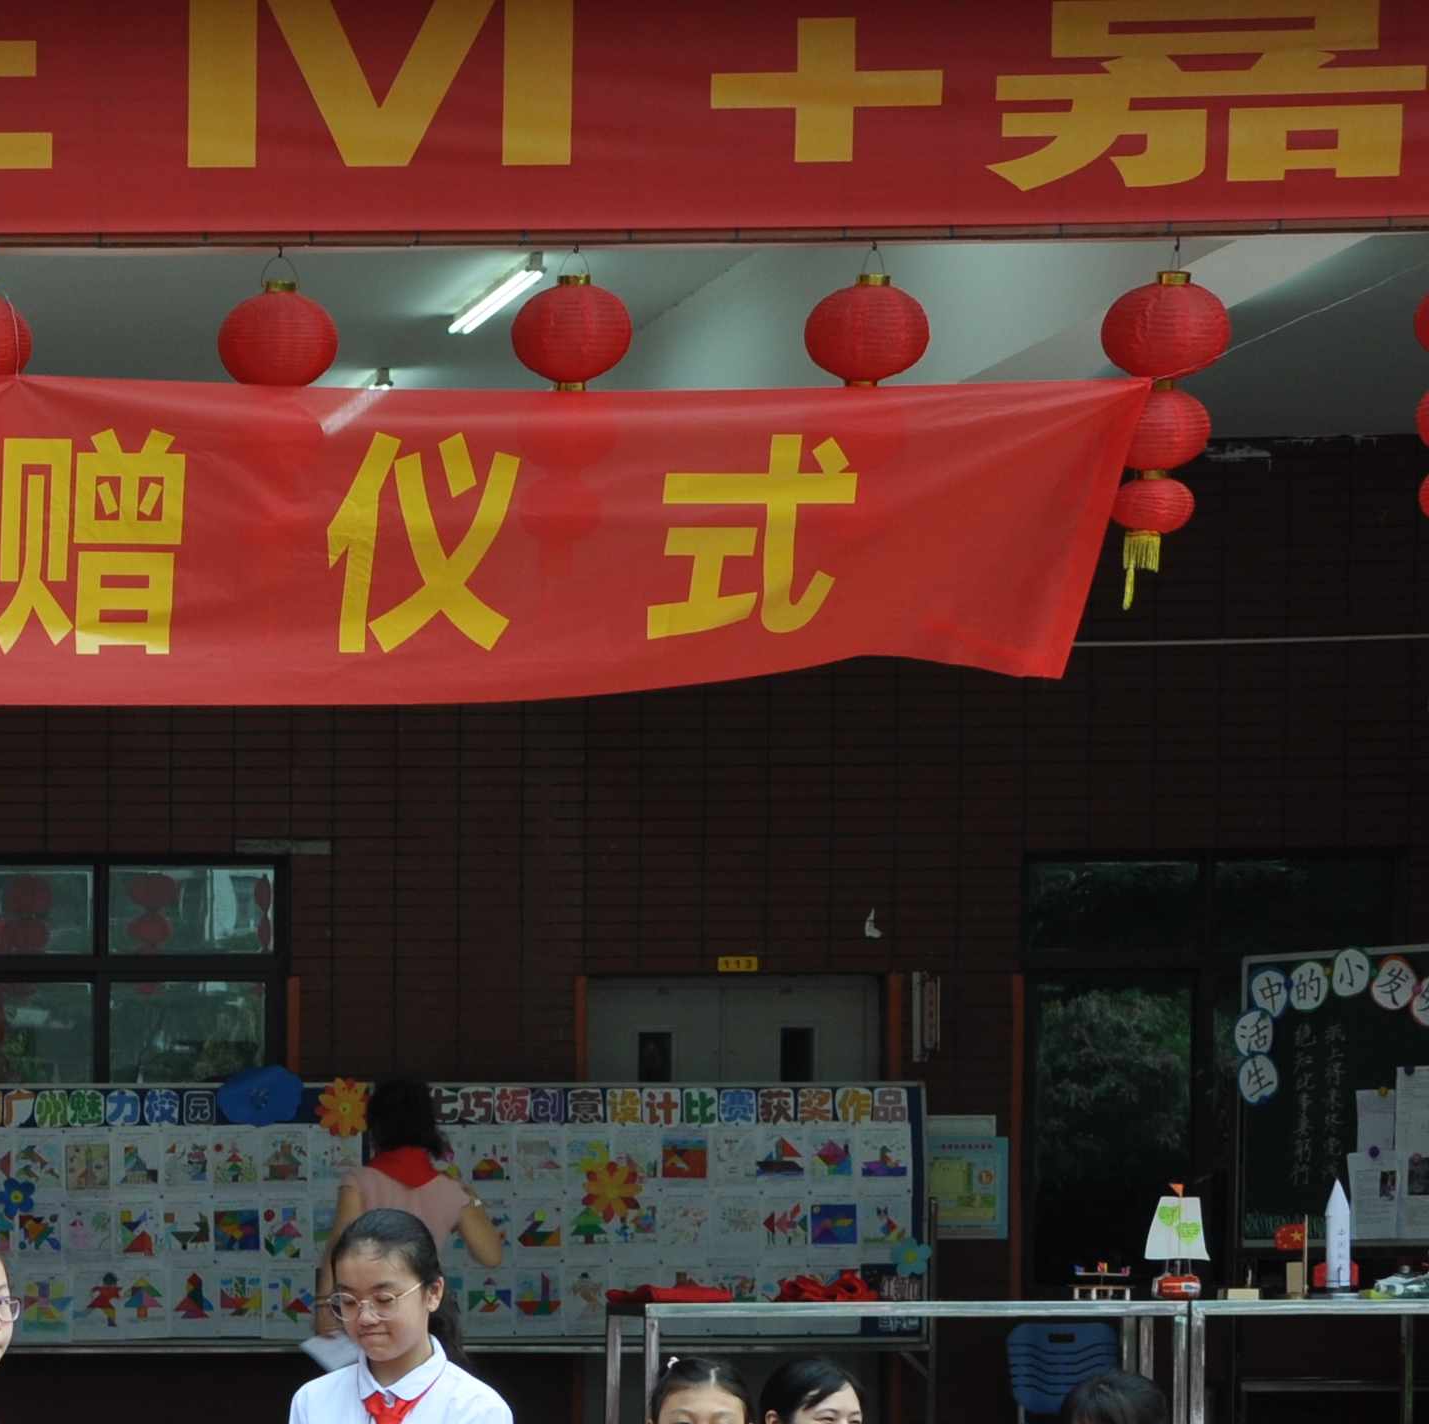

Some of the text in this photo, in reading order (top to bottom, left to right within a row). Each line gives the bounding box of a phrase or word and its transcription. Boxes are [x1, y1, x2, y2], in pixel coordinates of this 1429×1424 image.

[722, 959, 753, 970] 113
[431, 1088, 908, 1125] 七巧板创意设计比赛获奖作品
